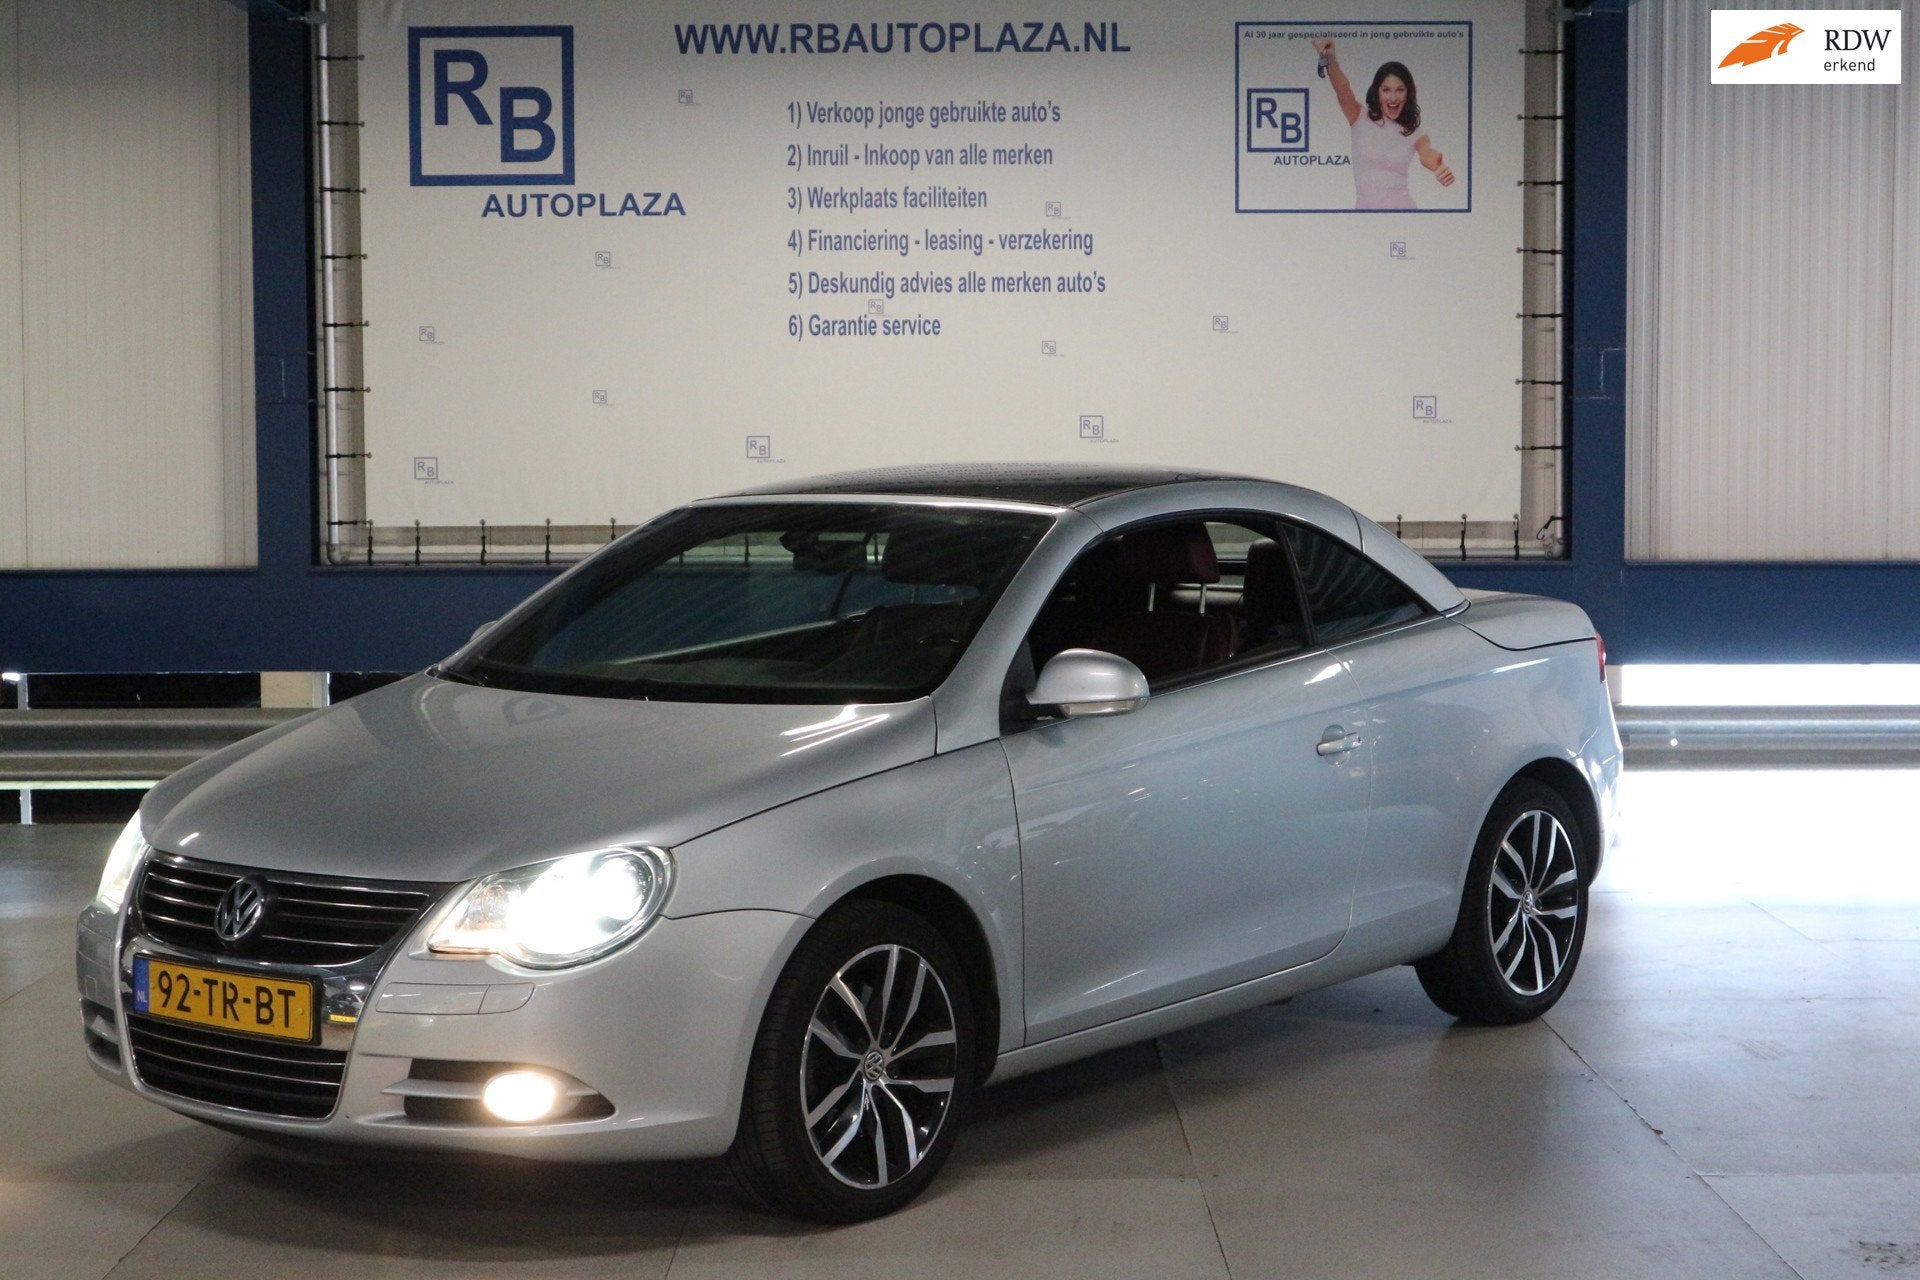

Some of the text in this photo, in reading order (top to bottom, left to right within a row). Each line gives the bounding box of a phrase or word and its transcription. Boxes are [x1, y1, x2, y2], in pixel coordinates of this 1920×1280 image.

[674, 22, 1131, 54] WWW.RBAUTOPLAZA.NL
[1243, 30, 1464, 40] Al 30 jaar gespecialiseerd in jong gebruikte auto's
[433, 50, 556, 162] RB
[788, 101, 801, 129] 1)
[807, 101, 875, 128] Verkoop
[878, 101, 925, 128] jonge
[930, 101, 1007, 128] gebruikte
[1256, 97, 1302, 143] RB
[788, 144, 802, 171] 2)
[807, 144, 849, 166] Inruil
[864, 144, 920, 171] Inkoop
[925, 149, 954, 166] van
[959, 143, 988, 166] alle
[993, 143, 1053, 165] merken
[1274, 155, 1351, 166] AUTOPLAZA
[481, 192, 687, 218] AUTOPLAZA
[788, 186, 987, 214] 3) Werkplaats faciliteiten
[788, 230, 802, 257] 4)
[808, 229, 909, 256] Financiering
[925, 229, 983, 256] leasing
[998, 229, 1094, 256] verzekering
[789, 273, 803, 299] 5)
[809, 272, 895, 299] Deskundig
[900, 272, 953, 294] advies
[958, 271, 986, 293] alle
[991, 271, 1052, 293] merken
[789, 314, 941, 342] 6) Garantie service
[157, 970, 297, 1029] 92-TR-BT
